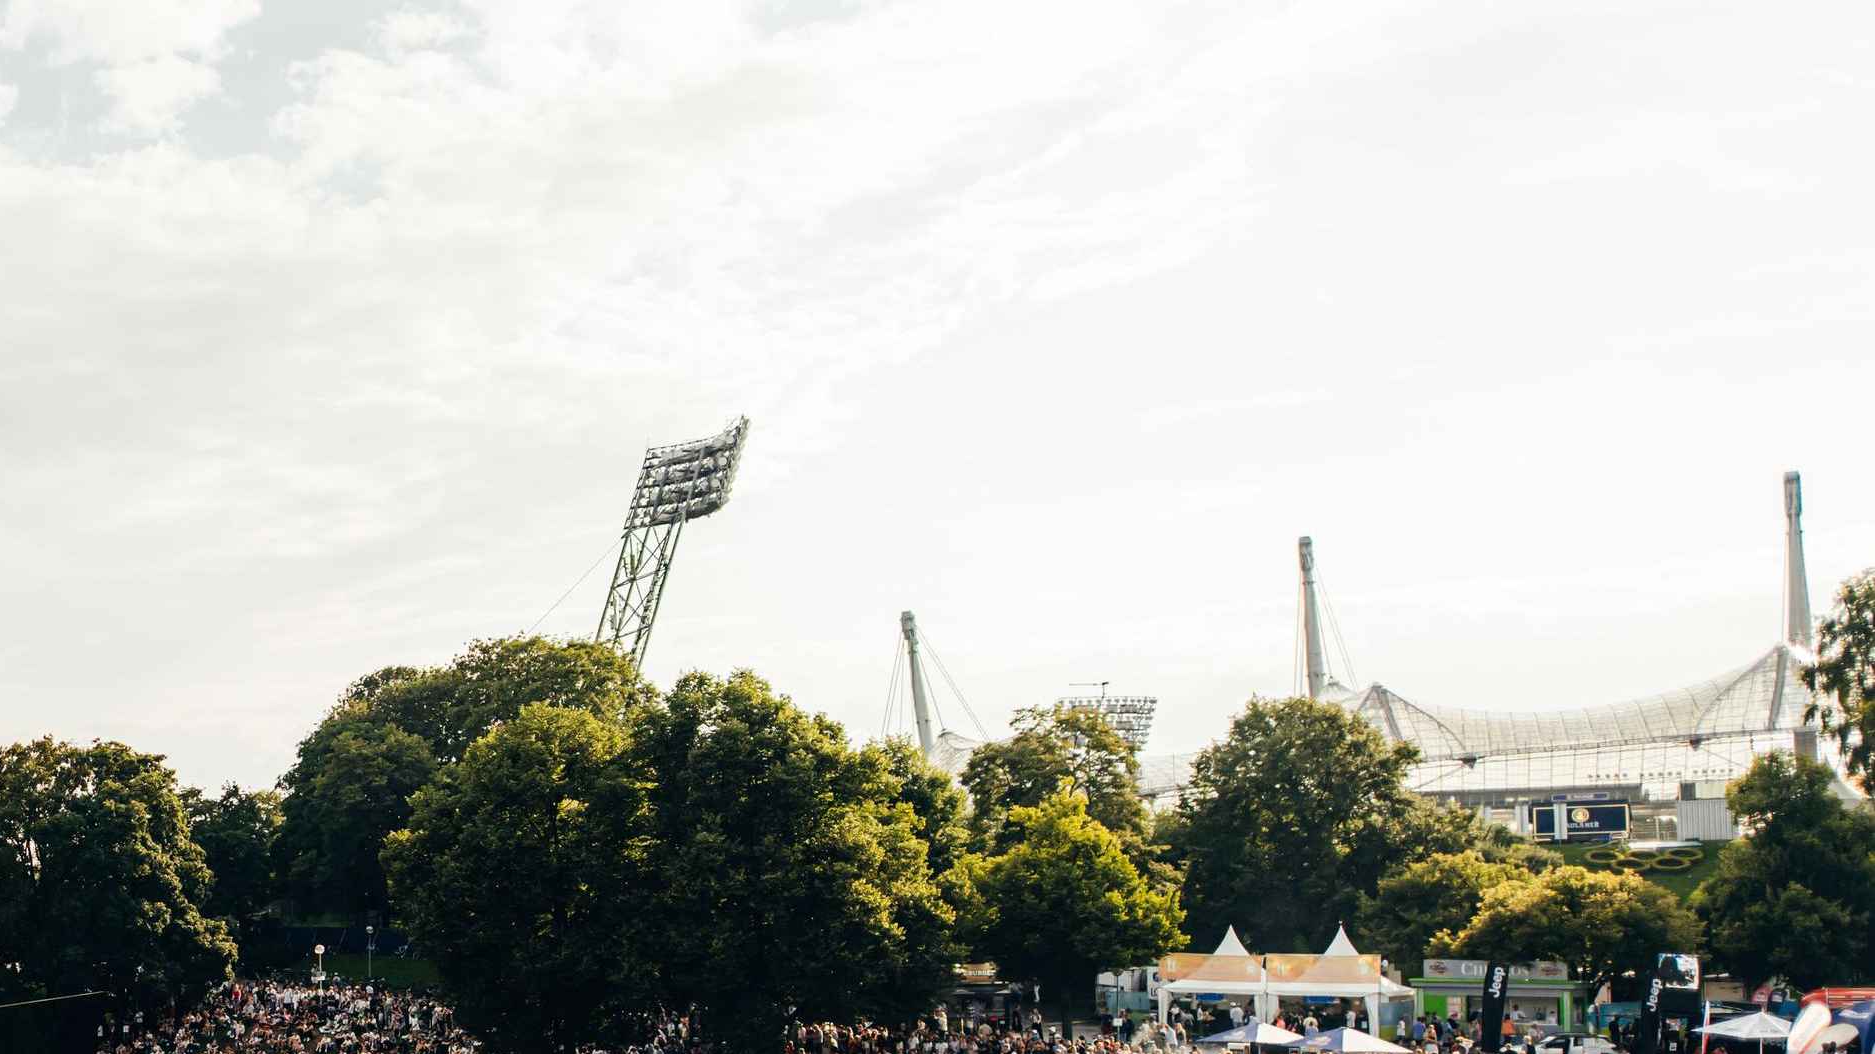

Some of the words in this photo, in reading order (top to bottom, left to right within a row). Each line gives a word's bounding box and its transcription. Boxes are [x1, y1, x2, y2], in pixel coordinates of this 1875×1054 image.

[1566, 821, 1600, 830] AULANER
[1489, 966, 1505, 998] Jeep
[1646, 978, 1663, 1013] Jeep
